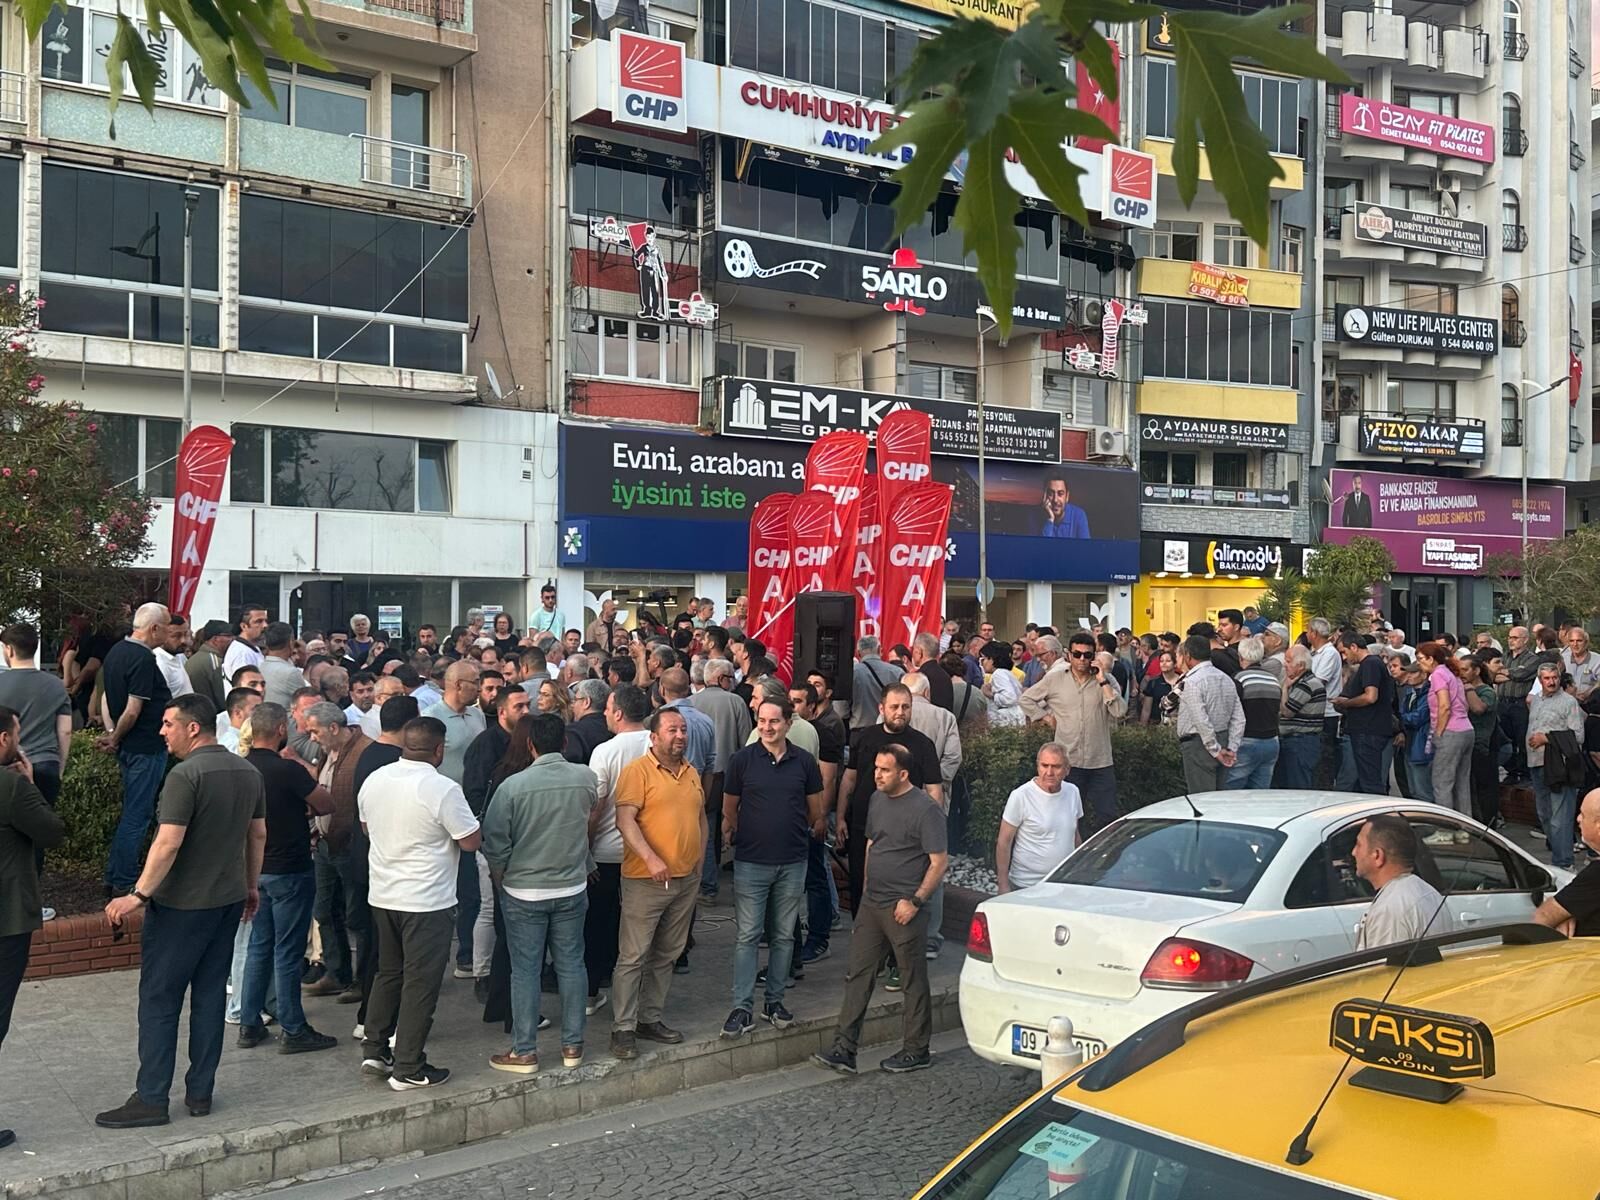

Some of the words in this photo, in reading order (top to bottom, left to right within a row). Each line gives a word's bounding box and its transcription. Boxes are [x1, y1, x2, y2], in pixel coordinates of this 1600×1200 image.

[625, 93, 678, 122] CHP
[740, 81, 909, 134] CUMHURİYE
[1379, 105, 1424, 132] ÖZAY
[1381, 127, 1402, 138] DEMET
[1113, 197, 1149, 220] CHP
[1394, 220, 1423, 232] KADRİYE
[1423, 225, 1452, 237] BOZKURT
[1453, 230, 1480, 241] ERAYDIN
[1411, 213, 1434, 224] AHMET
[1434, 217, 1464, 229] BOZKURT
[1393, 229, 1416, 241] EĞİTİM
[1417, 233, 1442, 245] KÜLTÜR
[1443, 238, 1462, 248] SANAT
[1200, 286, 1217, 297] 507
[1026, 307, 1034, 318] &
[1034, 308, 1049, 320] bar
[1372, 311, 1396, 330] NEW
[1398, 313, 1418, 331] LIFE
[1419, 316, 1456, 335] PILATES
[1458, 319, 1494, 339] CENTER
[1371, 331, 1396, 343] Gülten
[1397, 334, 1434, 346] DURUKAN
[1441, 338, 1447, 347] 0
[1447, 339, 1461, 348] 544
[1461, 340, 1474, 350] 604
[1475, 341, 1484, 351] 60
[1485, 342, 1494, 352] 09
[967, 409, 1017, 423] PRFESYONEL
[985, 423, 1022, 436] APARTMAN
[1023, 425, 1055, 439] YÖNETİMİ
[1163, 420, 1227, 434] AYDANUR
[1230, 423, 1287, 438] SİGORTA
[1420, 425, 1459, 442] AKAR
[933, 430, 938, 440] 0
[940, 431, 953, 441] 545
[954, 433, 968, 442] 552
[996, 437, 1013, 446] 0552
[1029, 440, 1038, 449] 33
[613, 442, 683, 475] Evini,
[690, 452, 786, 479] arabanı
[791, 463, 806, 480] a
[883, 461, 930, 482] CHP
[612, 478, 694, 510] iyisini
[700, 484, 747, 509] iste
[1379, 482, 1413, 497] BANKASIZ
[1414, 479, 1438, 495] FAİZSİZ
[1379, 500, 1388, 513] EV
[1389, 498, 1399, 512] VE
[1400, 497, 1423, 512] ARABA
[1423, 494, 1478, 510] FİNANSMANINDA
[1473, 510, 1486, 522] YTS
[1511, 511, 1551, 524] sinpsyts.com
[795, 546, 833, 567] CHP
[890, 543, 944, 568] CHP
[1426, 551, 1444, 561] YAPI
[1219, 561, 1257, 572] BAKLAVA
[1021, 1031, 1037, 1051] 09
[1378, 1056, 1436, 1073] AYDIN
[1397, 1051, 1413, 1062] 09
